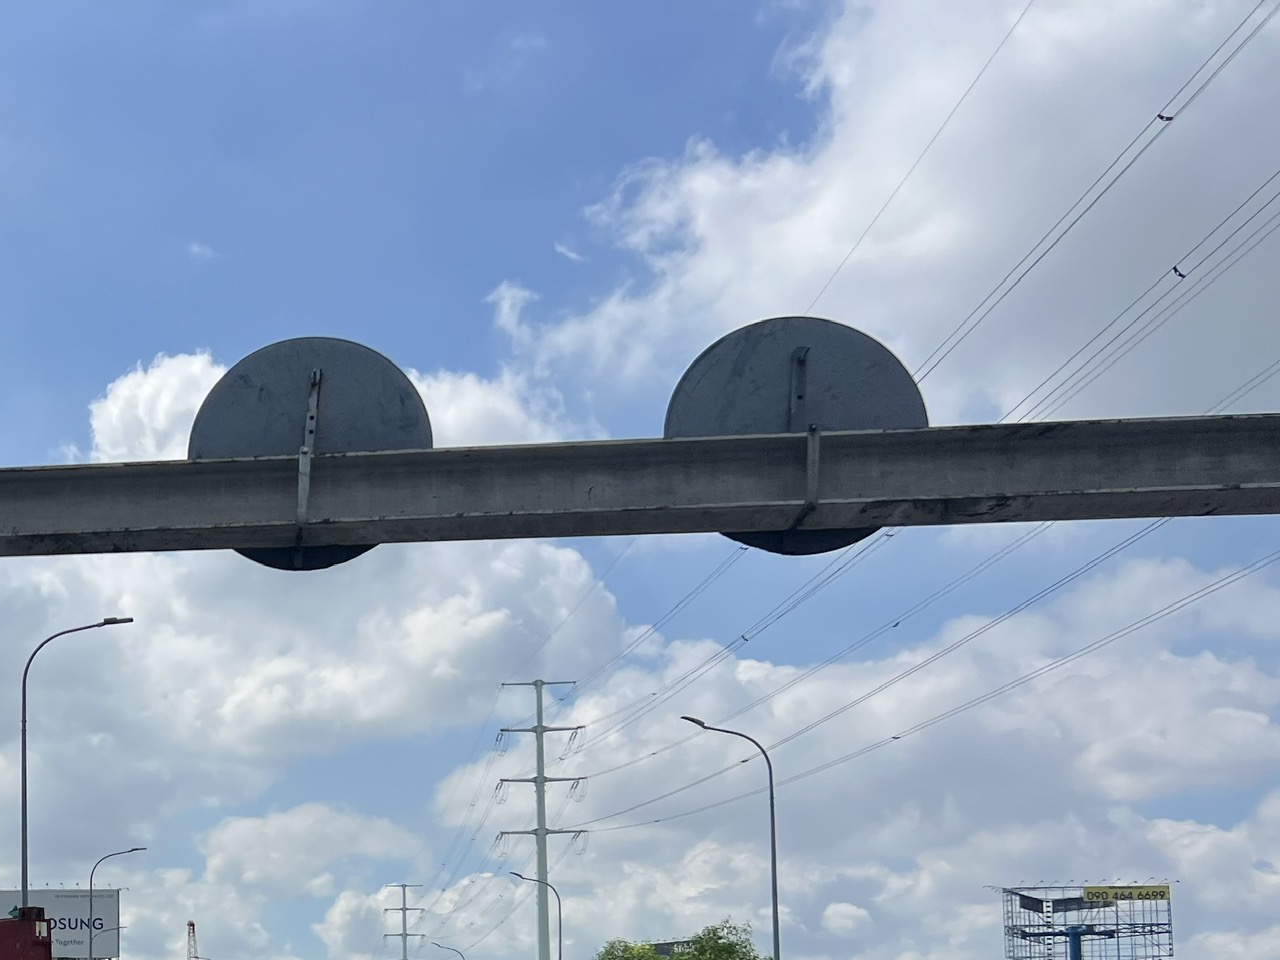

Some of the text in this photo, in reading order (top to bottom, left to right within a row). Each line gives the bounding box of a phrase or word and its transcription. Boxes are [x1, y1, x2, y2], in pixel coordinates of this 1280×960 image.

[1087, 890, 1166, 901] 090 464 6699
[49, 917, 104, 930] OSUNG
